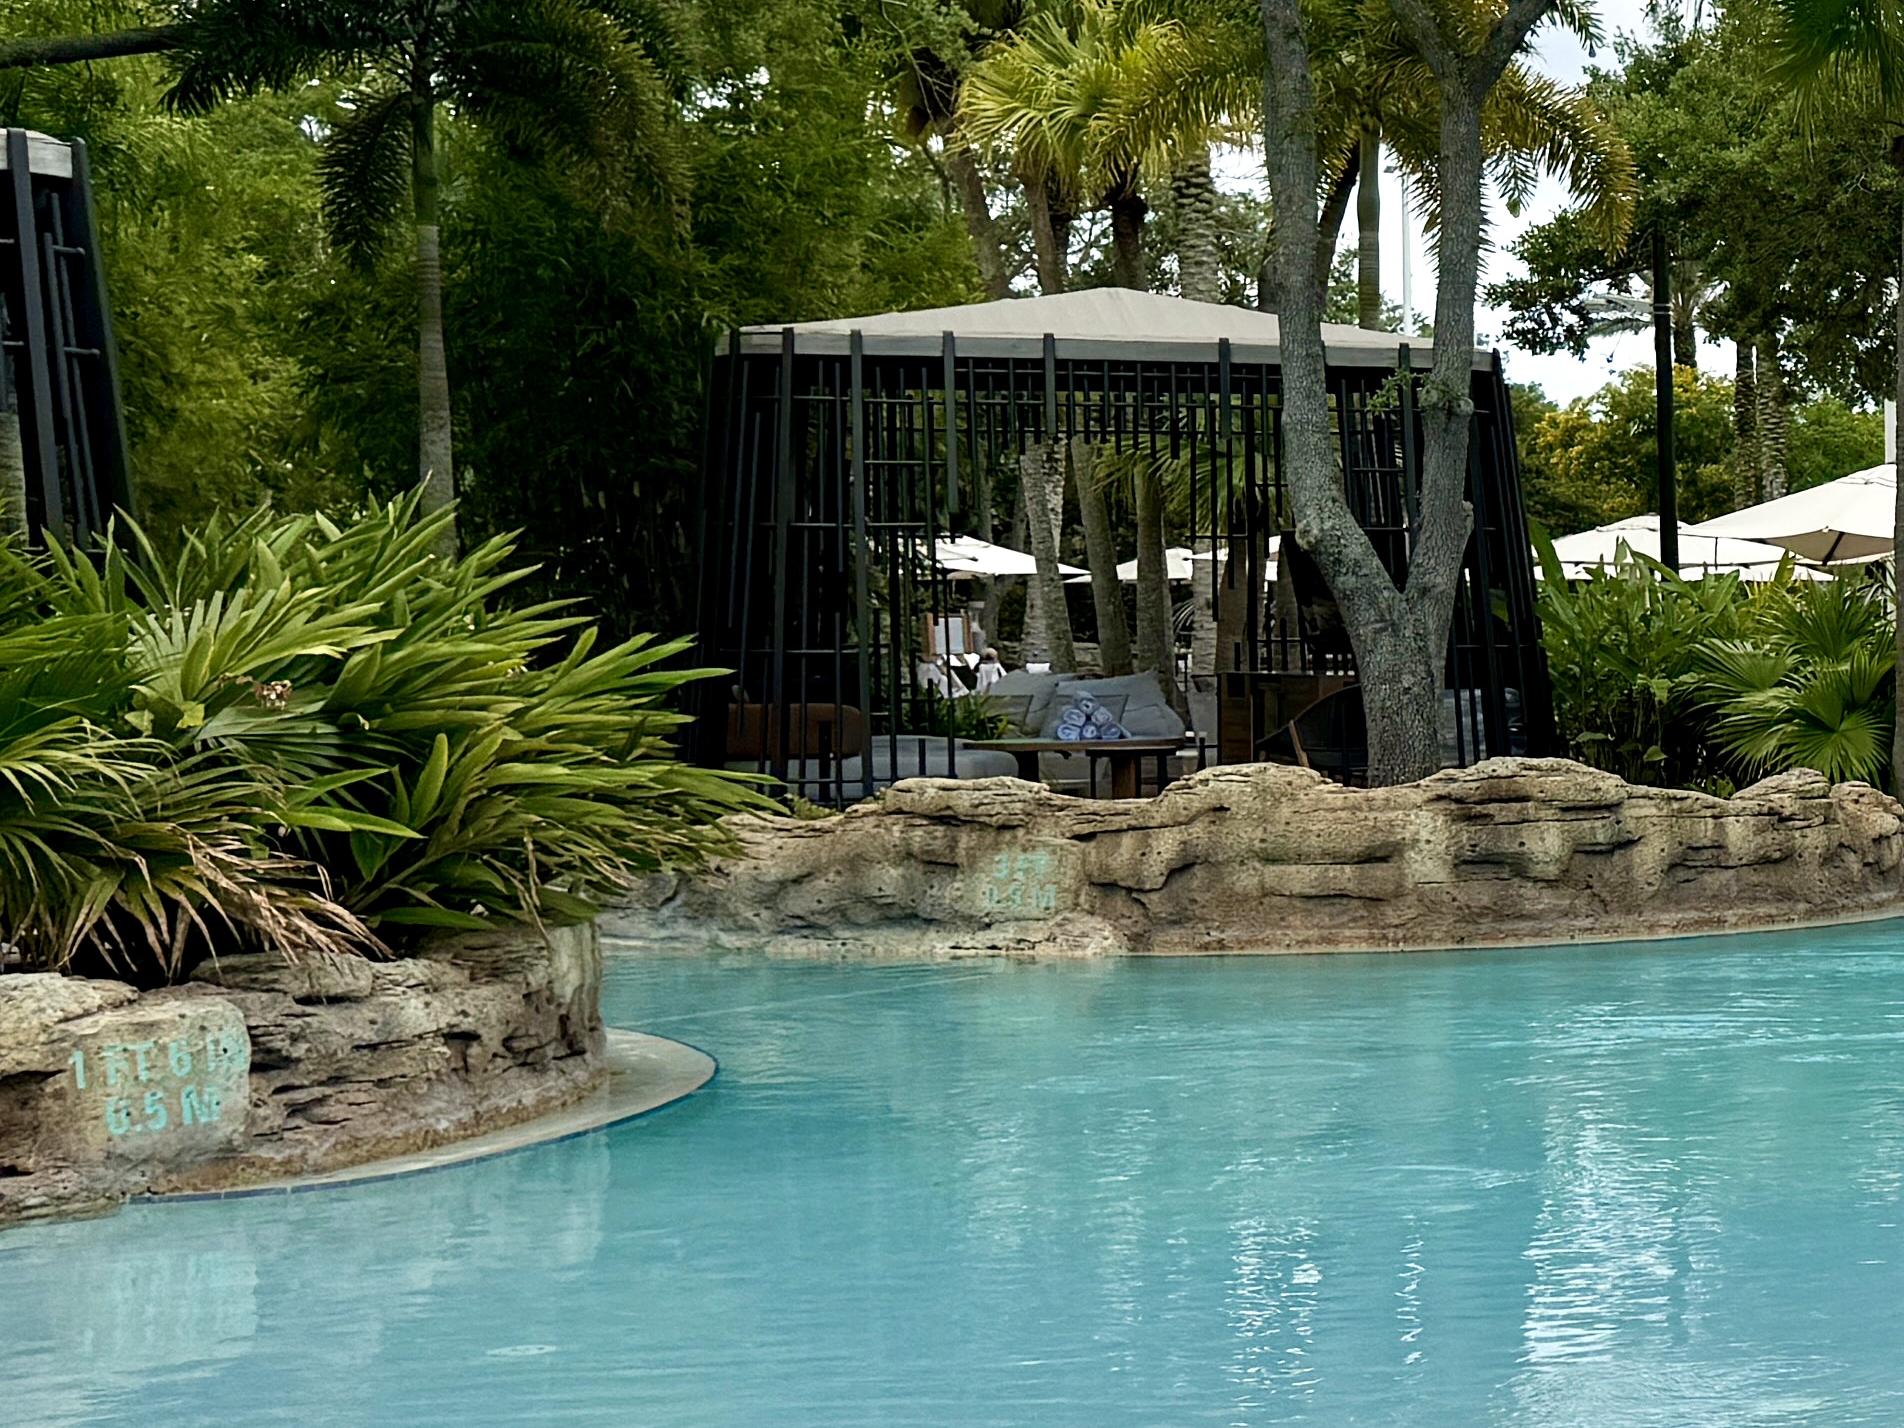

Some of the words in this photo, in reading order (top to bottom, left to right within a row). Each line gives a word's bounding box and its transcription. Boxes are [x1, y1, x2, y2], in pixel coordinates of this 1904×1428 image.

[68, 1050, 87, 1090] 1
[103, 1039, 157, 1087] FT
[168, 1037, 194, 1078] 6
